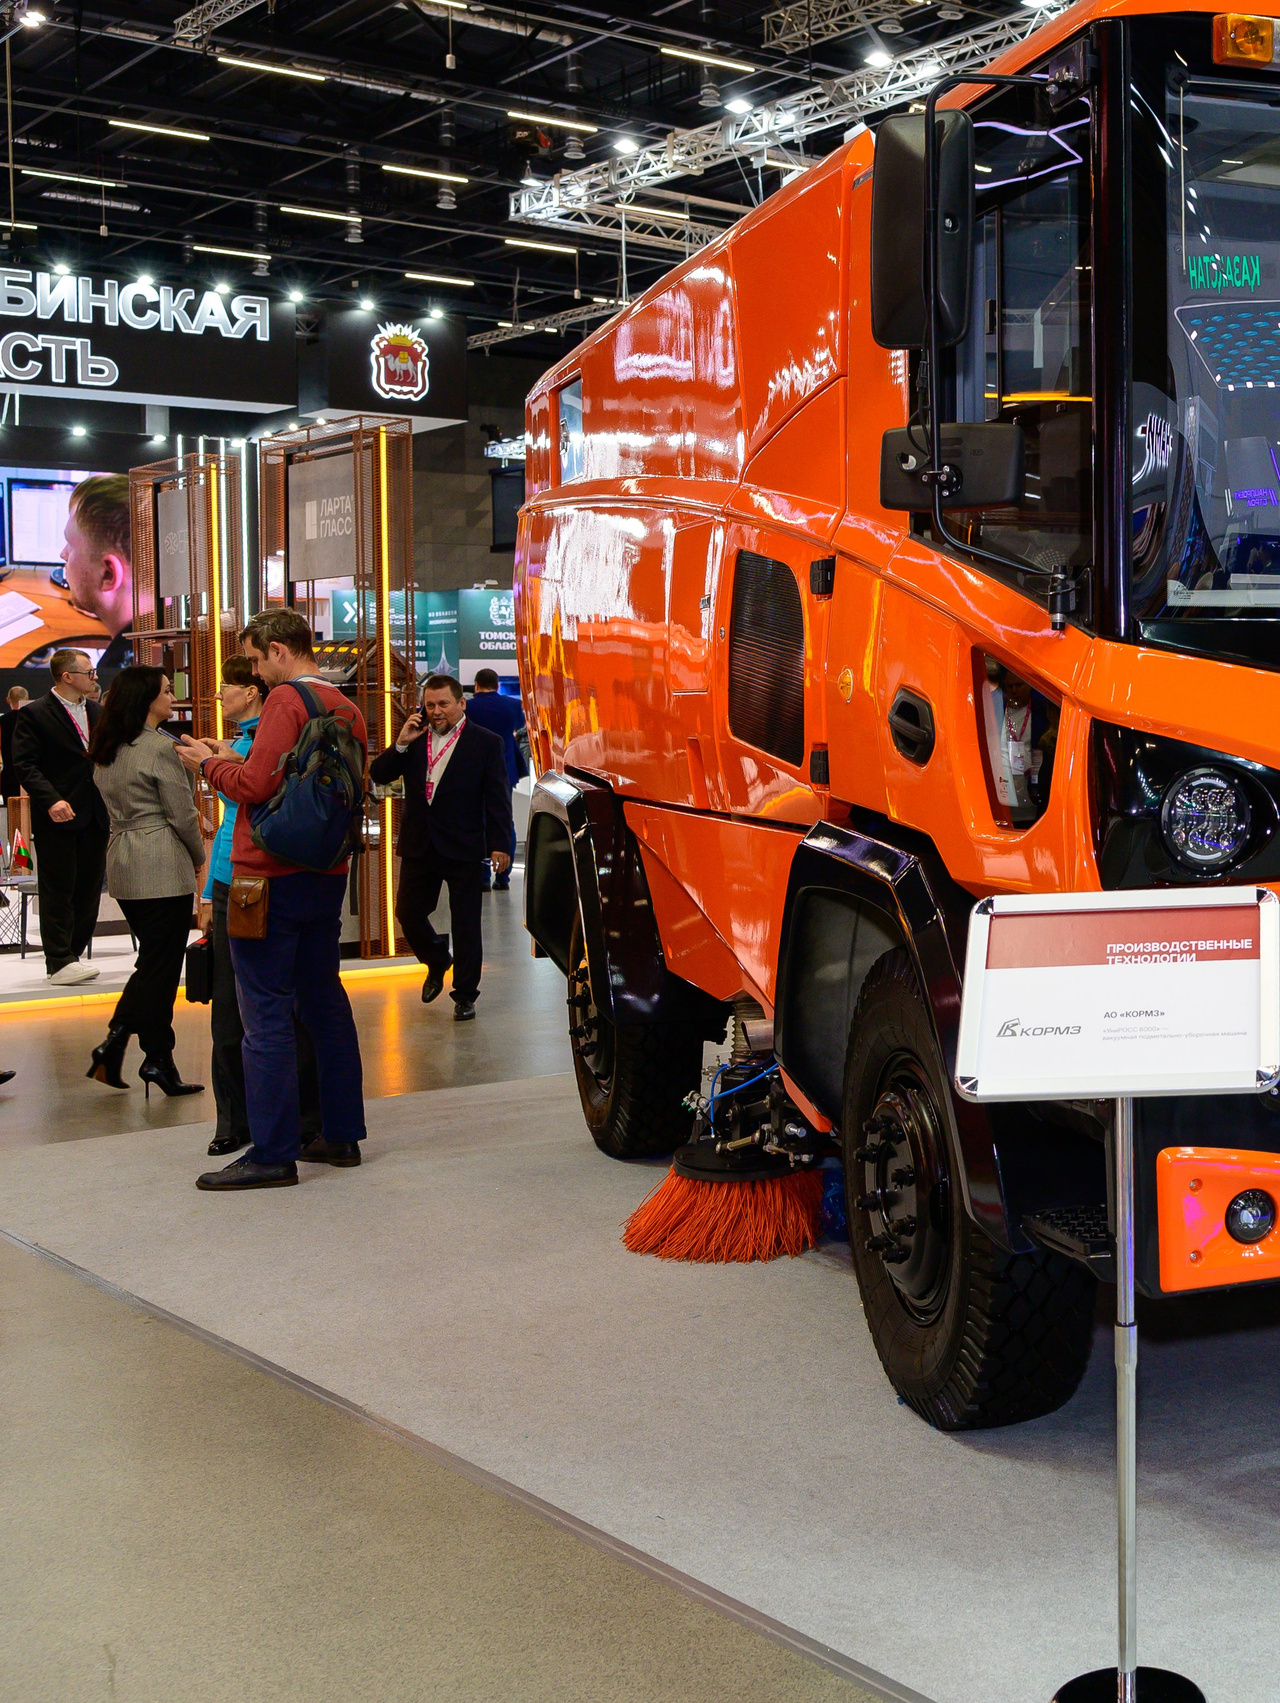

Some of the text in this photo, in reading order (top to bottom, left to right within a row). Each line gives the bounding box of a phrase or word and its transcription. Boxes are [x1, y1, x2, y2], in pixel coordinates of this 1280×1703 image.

[0, 268, 270, 342] БИНСКАЯ
[0, 331, 119, 386] СТЬ
[320, 495, 352, 517] ЛАРТА
[320, 516, 352, 538] ГЛАСС
[1106, 938, 1253, 954] ПРОИЗВОДСТВЕННЫЕ
[1106, 952, 1196, 965] ТЕХНОЛОГИИ
[1103, 1010, 1118, 1019] АО
[1019, 1025, 1082, 1037] КОРМЗ
[1220, 1030, 1247, 1038] машина
